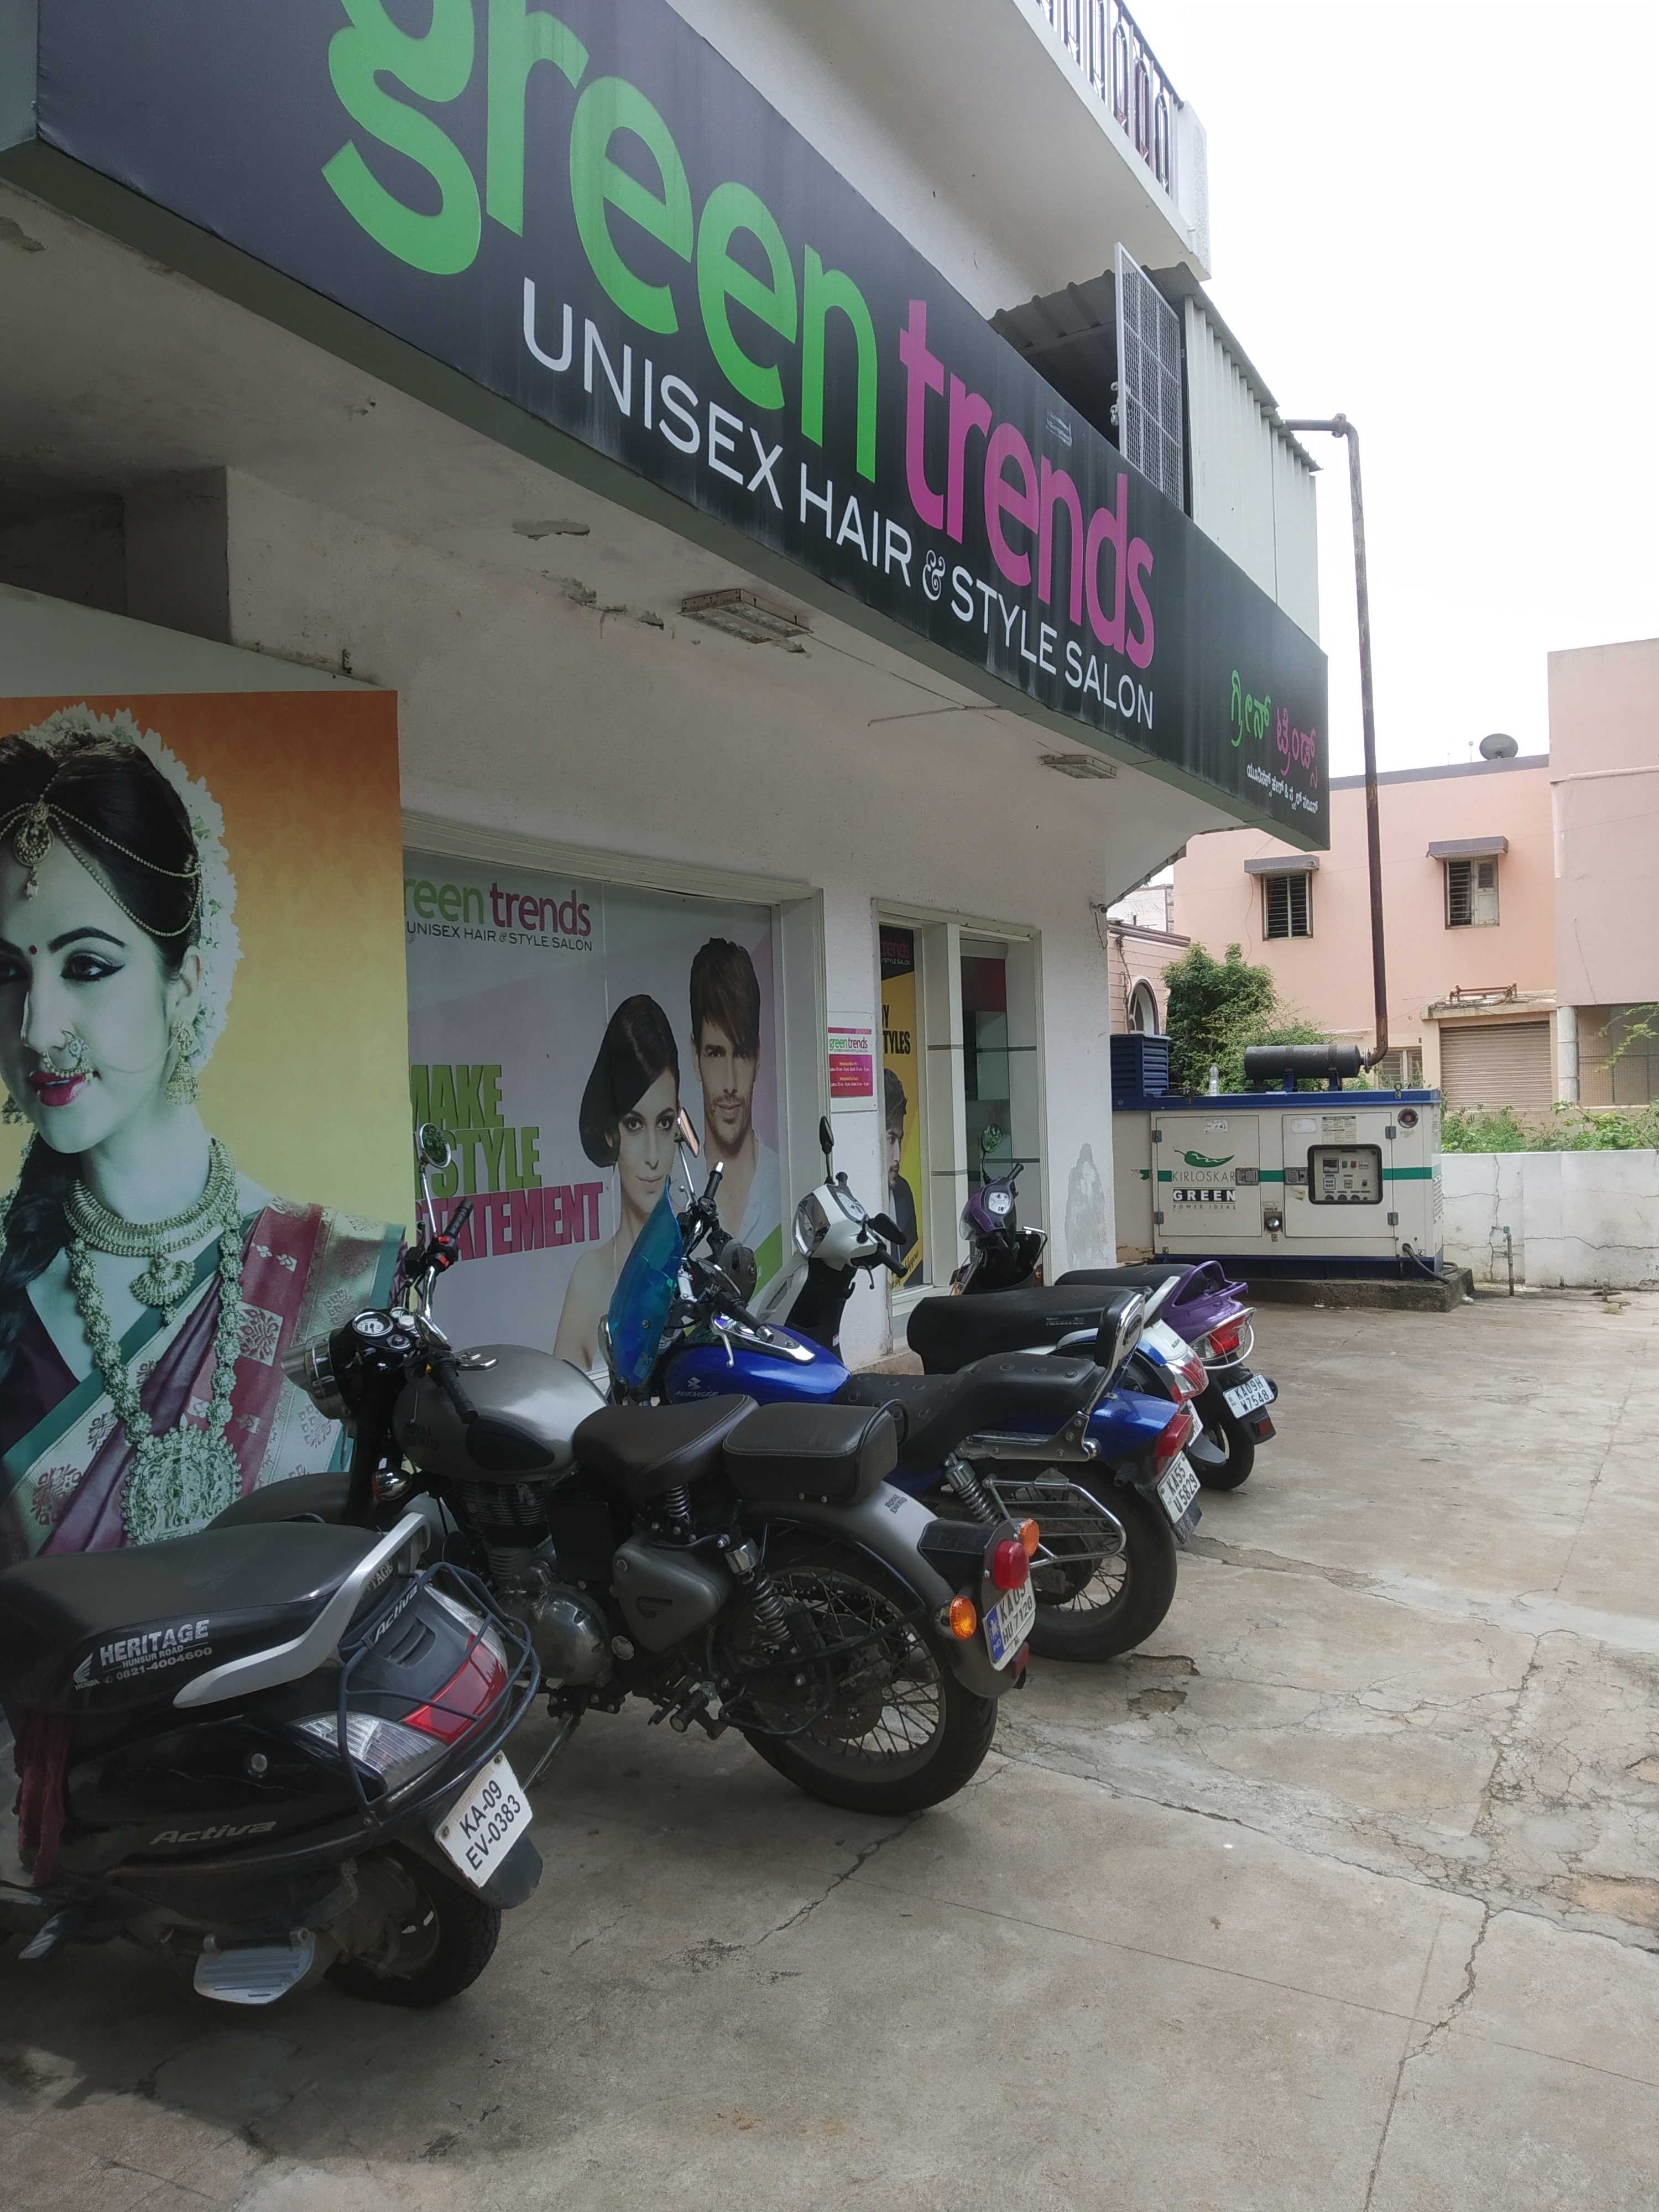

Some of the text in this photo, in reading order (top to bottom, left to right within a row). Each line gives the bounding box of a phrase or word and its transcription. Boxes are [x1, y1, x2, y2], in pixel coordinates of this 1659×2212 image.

[321, 0, 1154, 669] green trends
[523, 276, 1154, 730] UNISEX HAIR & STYLE SALON
[404, 878, 591, 937] reen trends
[406, 921, 461, 939] UNISEX
[464, 928, 496, 942] HAIR
[509, 932, 549, 947] STYLE
[552, 937, 592, 952] SALON
[880, 937, 911, 961] rends
[829, 1036, 868, 1051] green trends
[883, 1030, 911, 1055] TYLES
[1172, 1170, 1235, 1182] KIRLOSKAR
[1172, 1190, 1236, 1201] GREEN
[1234, 1377, 1264, 1400] KA09H
[1166, 1462, 1186, 1496] KA55
[884, 1494, 900, 1509] ROYAL
[373, 1584, 418, 1644] Activa
[100, 1619, 210, 1666] HERITAGE
[116, 1646, 213, 1680] 0821-4004600
[122, 1645, 184, 1669] HUNSUR ROAD
[75, 1678, 100, 1691] HONDA
[458, 1780, 502, 1840] KA-09
[149, 1820, 276, 1845] Activa
[465, 1794, 521, 1871] EV-0383
